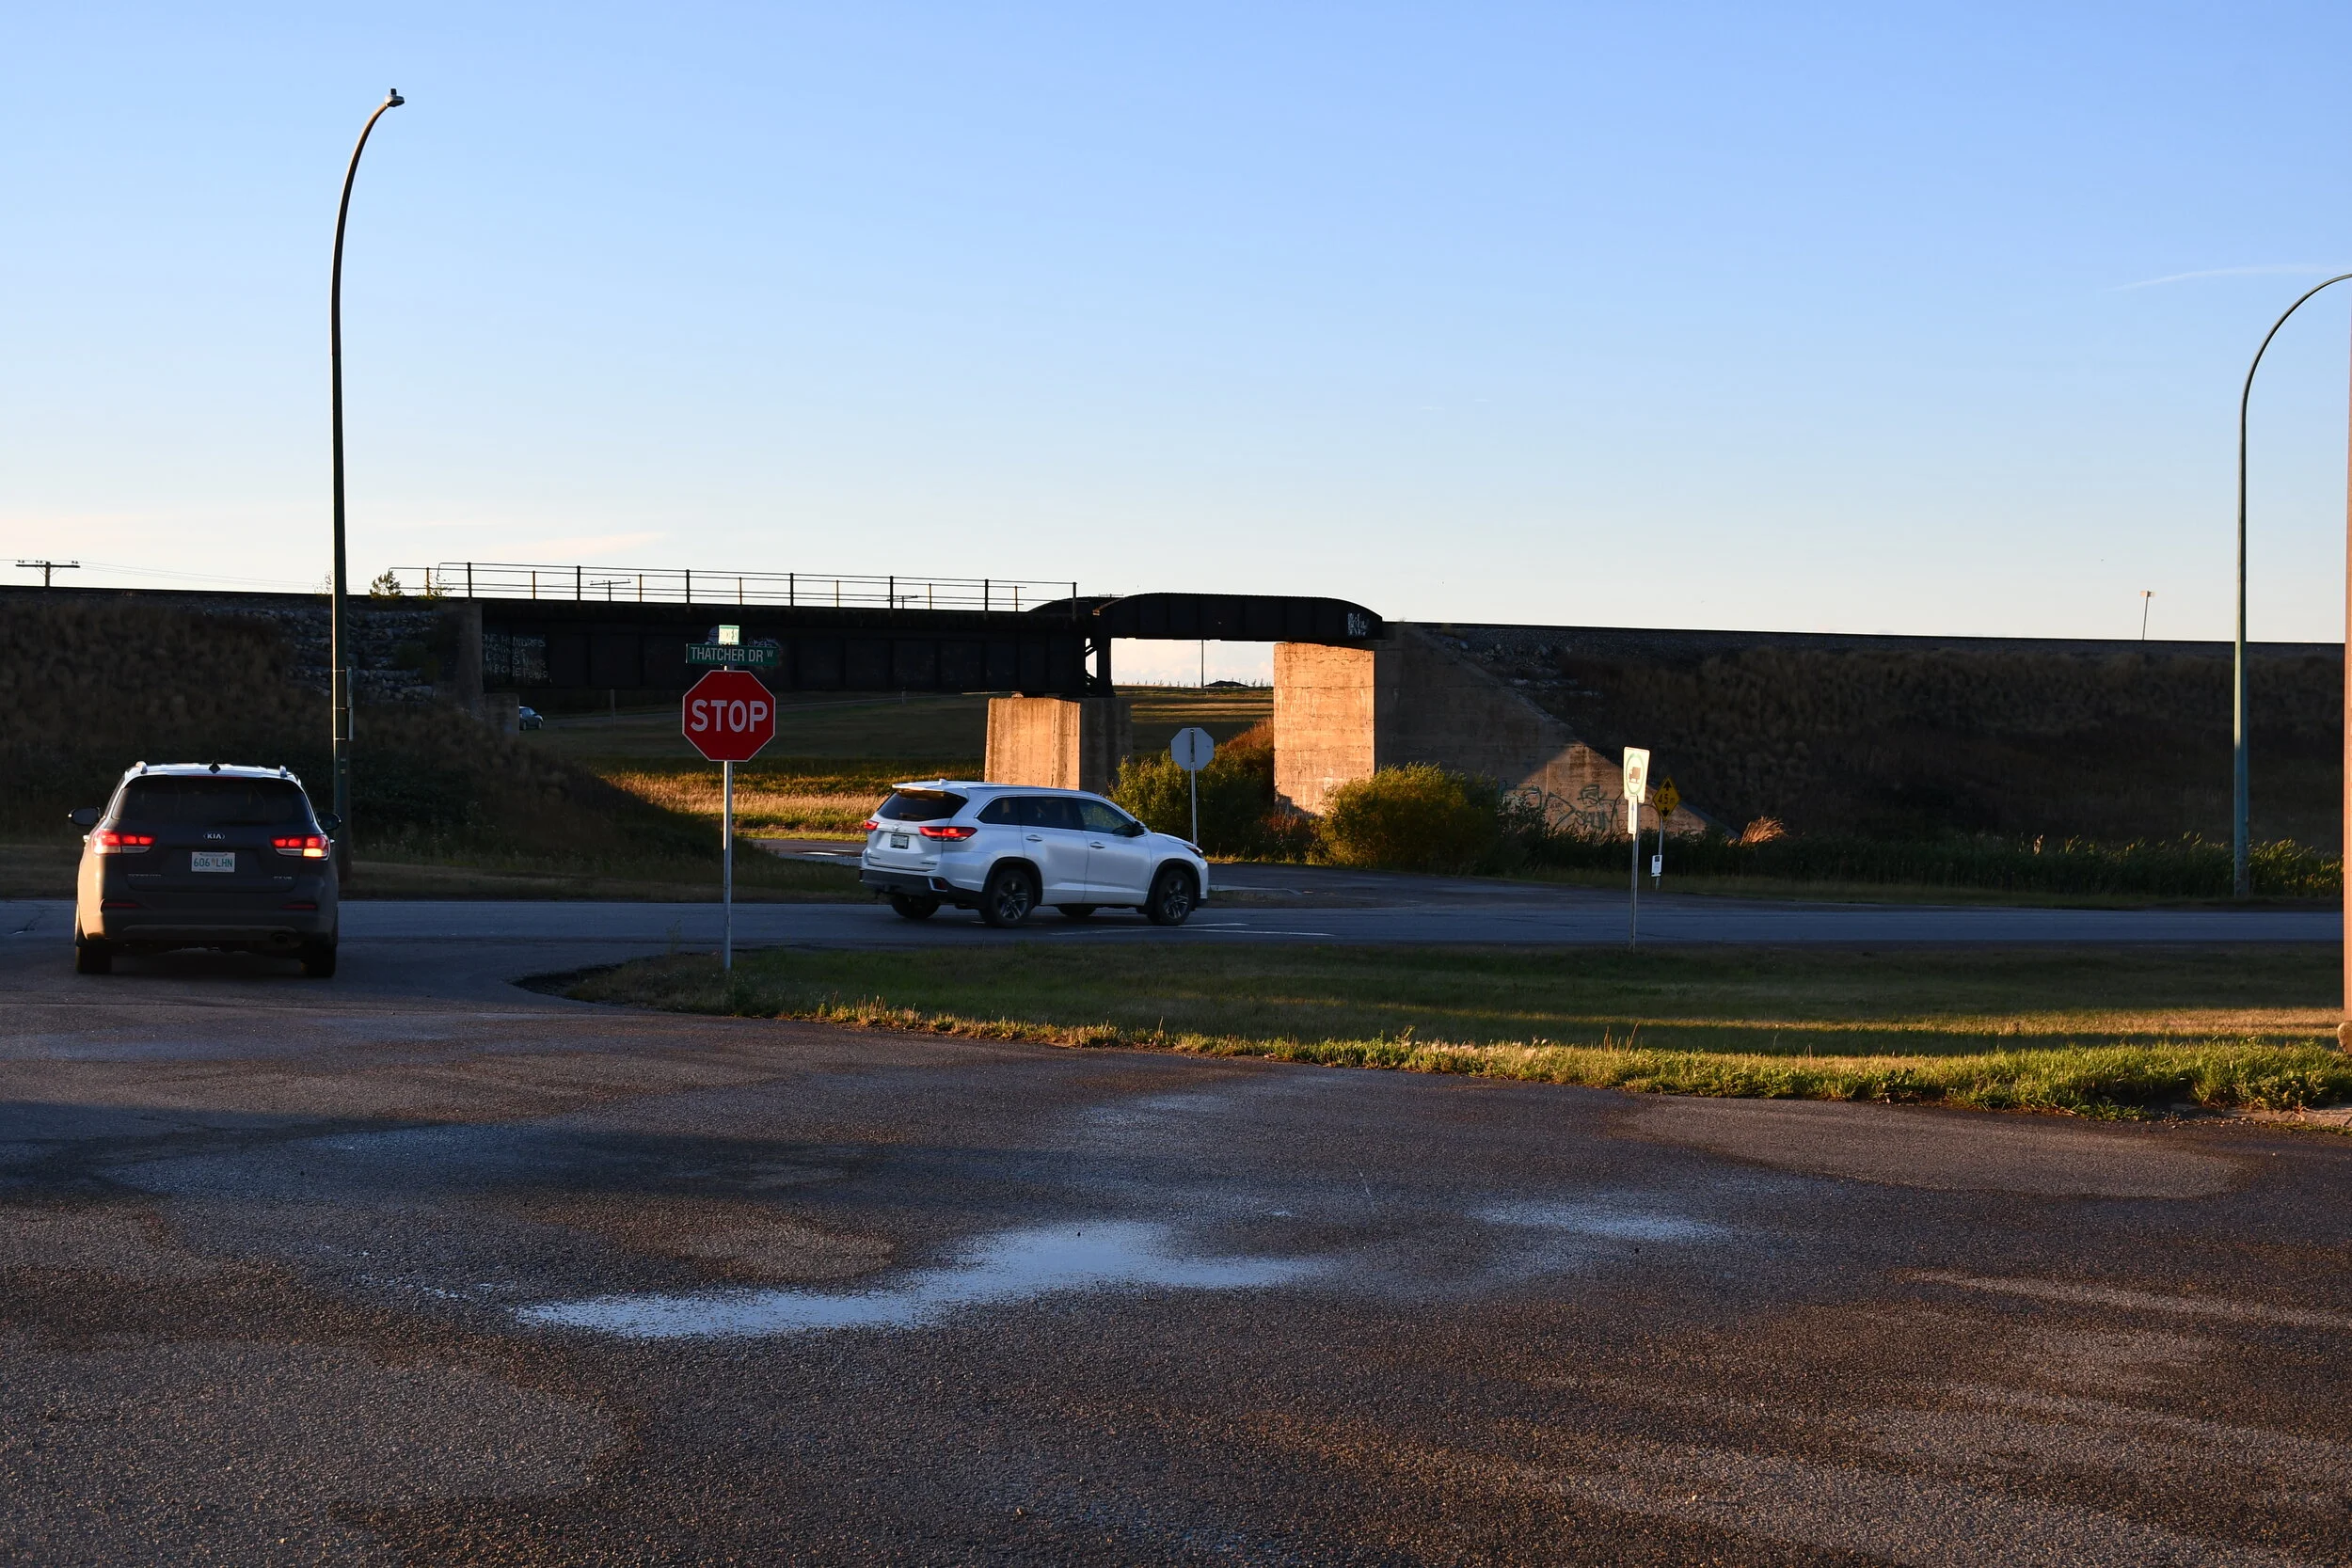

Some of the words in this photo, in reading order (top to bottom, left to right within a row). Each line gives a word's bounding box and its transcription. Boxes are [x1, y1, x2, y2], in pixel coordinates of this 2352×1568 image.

[691, 646, 744, 661] THATCHER
[749, 649, 764, 662] DR
[767, 649, 773, 657] W
[690, 699, 768, 733] STOP
[194, 858, 211, 866] 606
[216, 858, 232, 867] LHN
